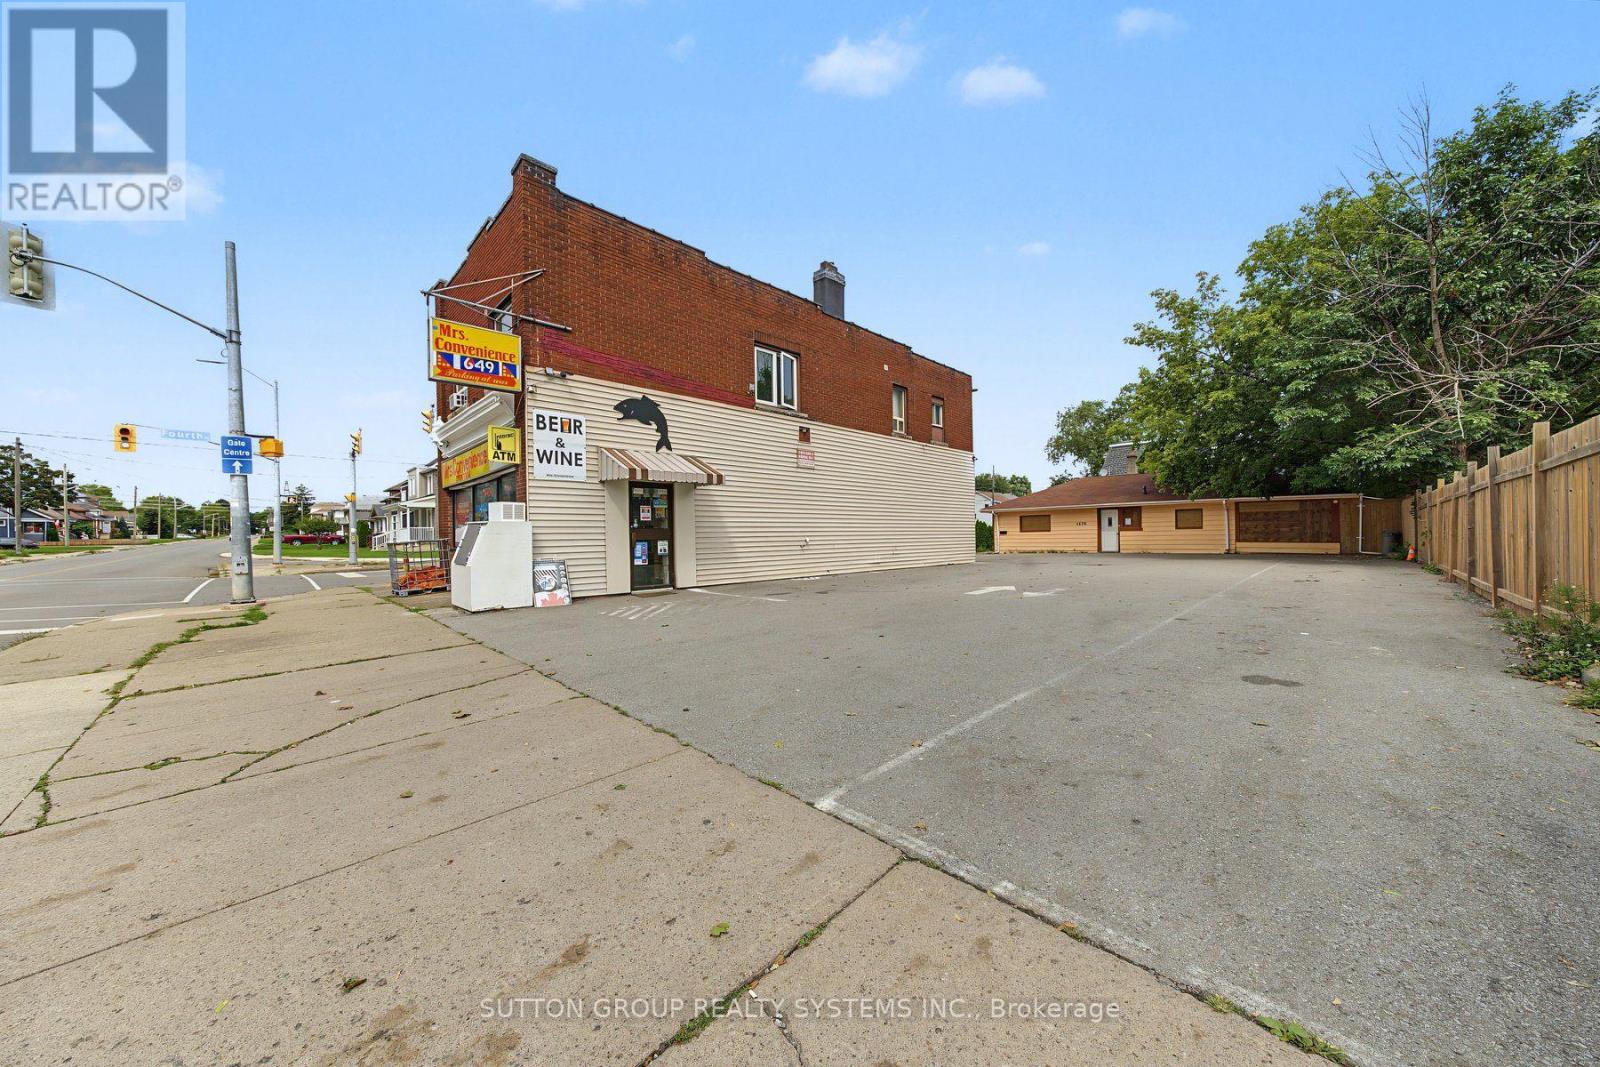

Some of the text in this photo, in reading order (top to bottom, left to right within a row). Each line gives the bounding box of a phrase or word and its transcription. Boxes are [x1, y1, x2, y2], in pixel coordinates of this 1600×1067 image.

[439, 323, 469, 341] Mrs.
[434, 337, 516, 363] Convenience
[536, 413, 583, 435] BER
[161, 426, 204, 440] Fourth
[227, 438, 246, 447] Gate
[555, 437, 565, 448] &
[223, 448, 250, 457] Centre
[492, 450, 516, 462] ATM
[536, 448, 583, 467] WINE
